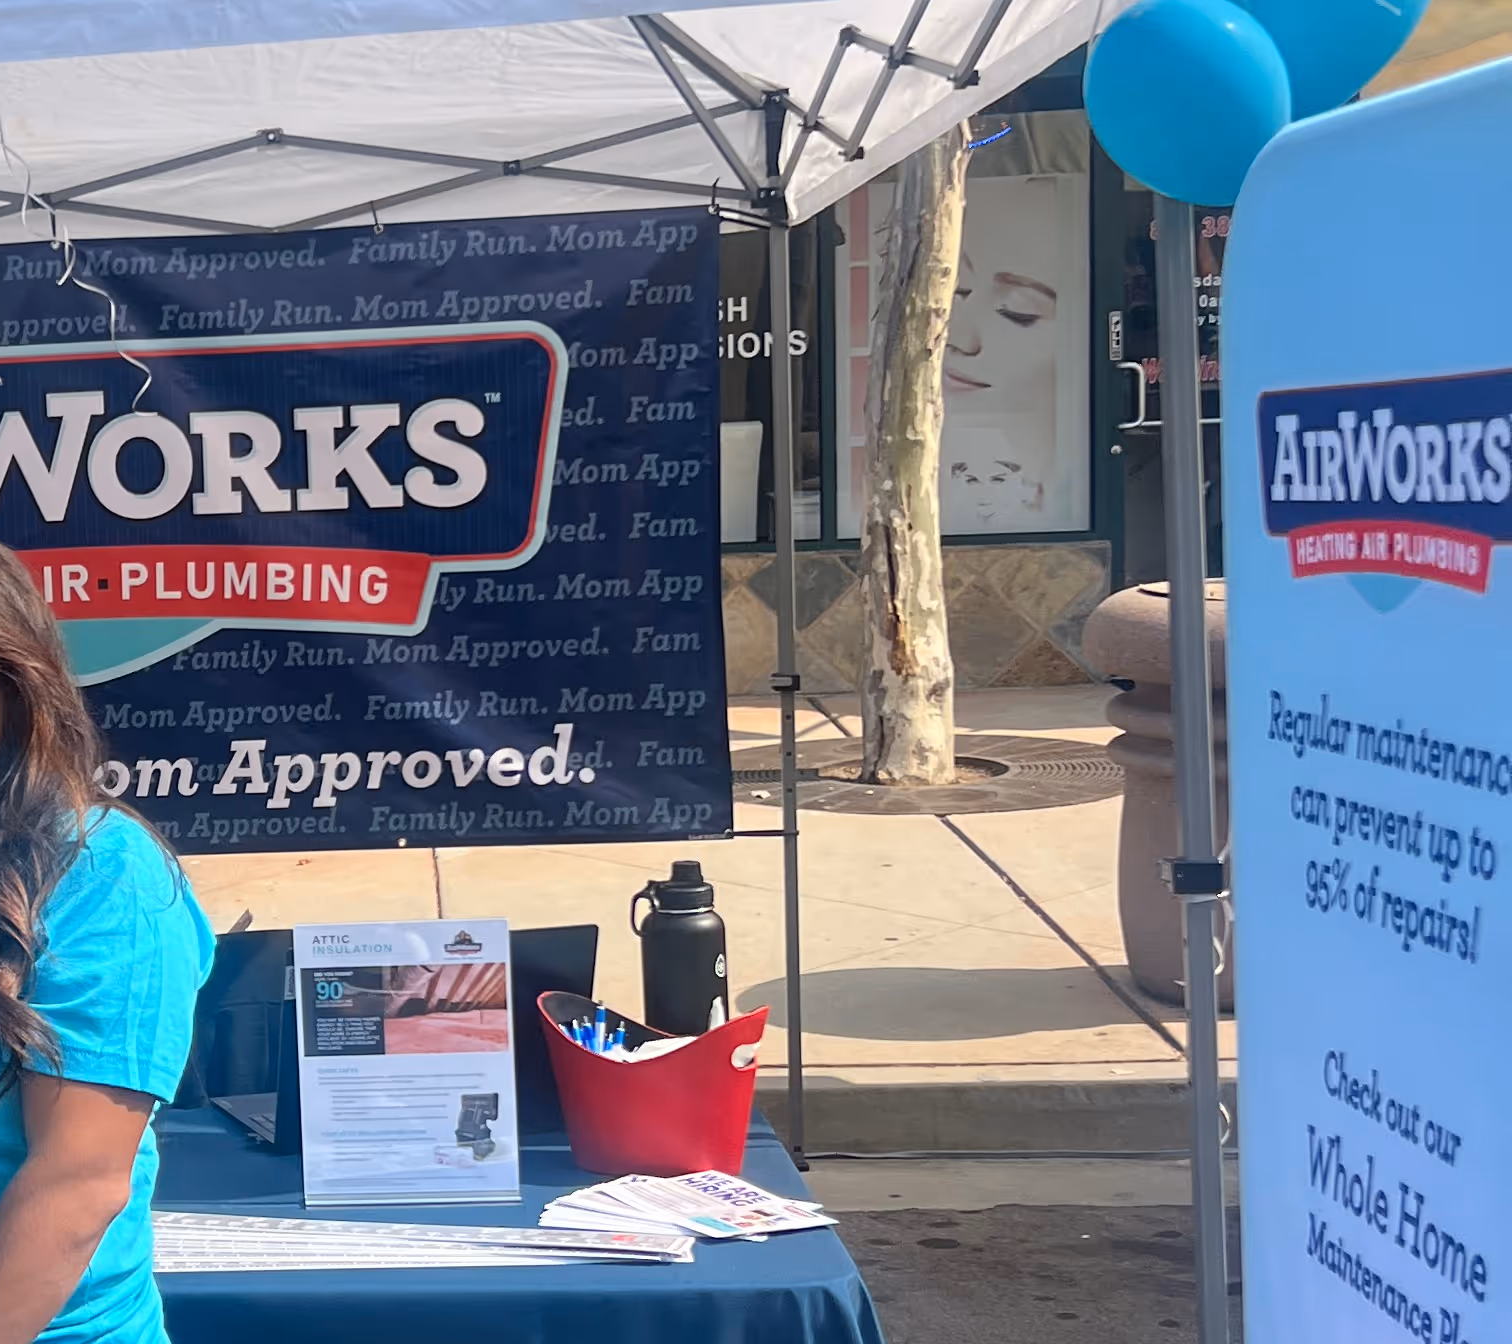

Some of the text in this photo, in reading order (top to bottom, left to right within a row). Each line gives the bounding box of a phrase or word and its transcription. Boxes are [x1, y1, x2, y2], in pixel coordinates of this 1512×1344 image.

[2, 256, 65, 282] Run
[83, 249, 158, 278] Mom
[163, 239, 327, 280] Approved.
[348, 228, 457, 266] Family
[464, 229, 538, 257] Run.
[547, 223, 626, 252] Mom
[1271, 408, 1512, 504] AIRWORKS
[42, 562, 388, 604] IR PLUMBING
[1297, 530, 1479, 576] HEATING AIR PLUMBING
[172, 639, 278, 675] Family
[284, 641, 356, 668] Run.
[363, 637, 440, 666] Mom
[444, 626, 610, 668] Approved.
[1268, 689, 1351, 759] Regular
[93, 757, 199, 798] om
[213, 723, 596, 809] Approved.
[1290, 785, 1497, 883] can prevent up to
[312, 934, 351, 945] ATTIC
[1305, 857, 1481, 965] 95% of repairs!
[312, 943, 393, 955] INSULATION
[1323, 1050, 1461, 1167] Check out our
[700, 1172, 772, 1206] WE ARE
[1307, 1123, 1487, 1303] Whole Home
